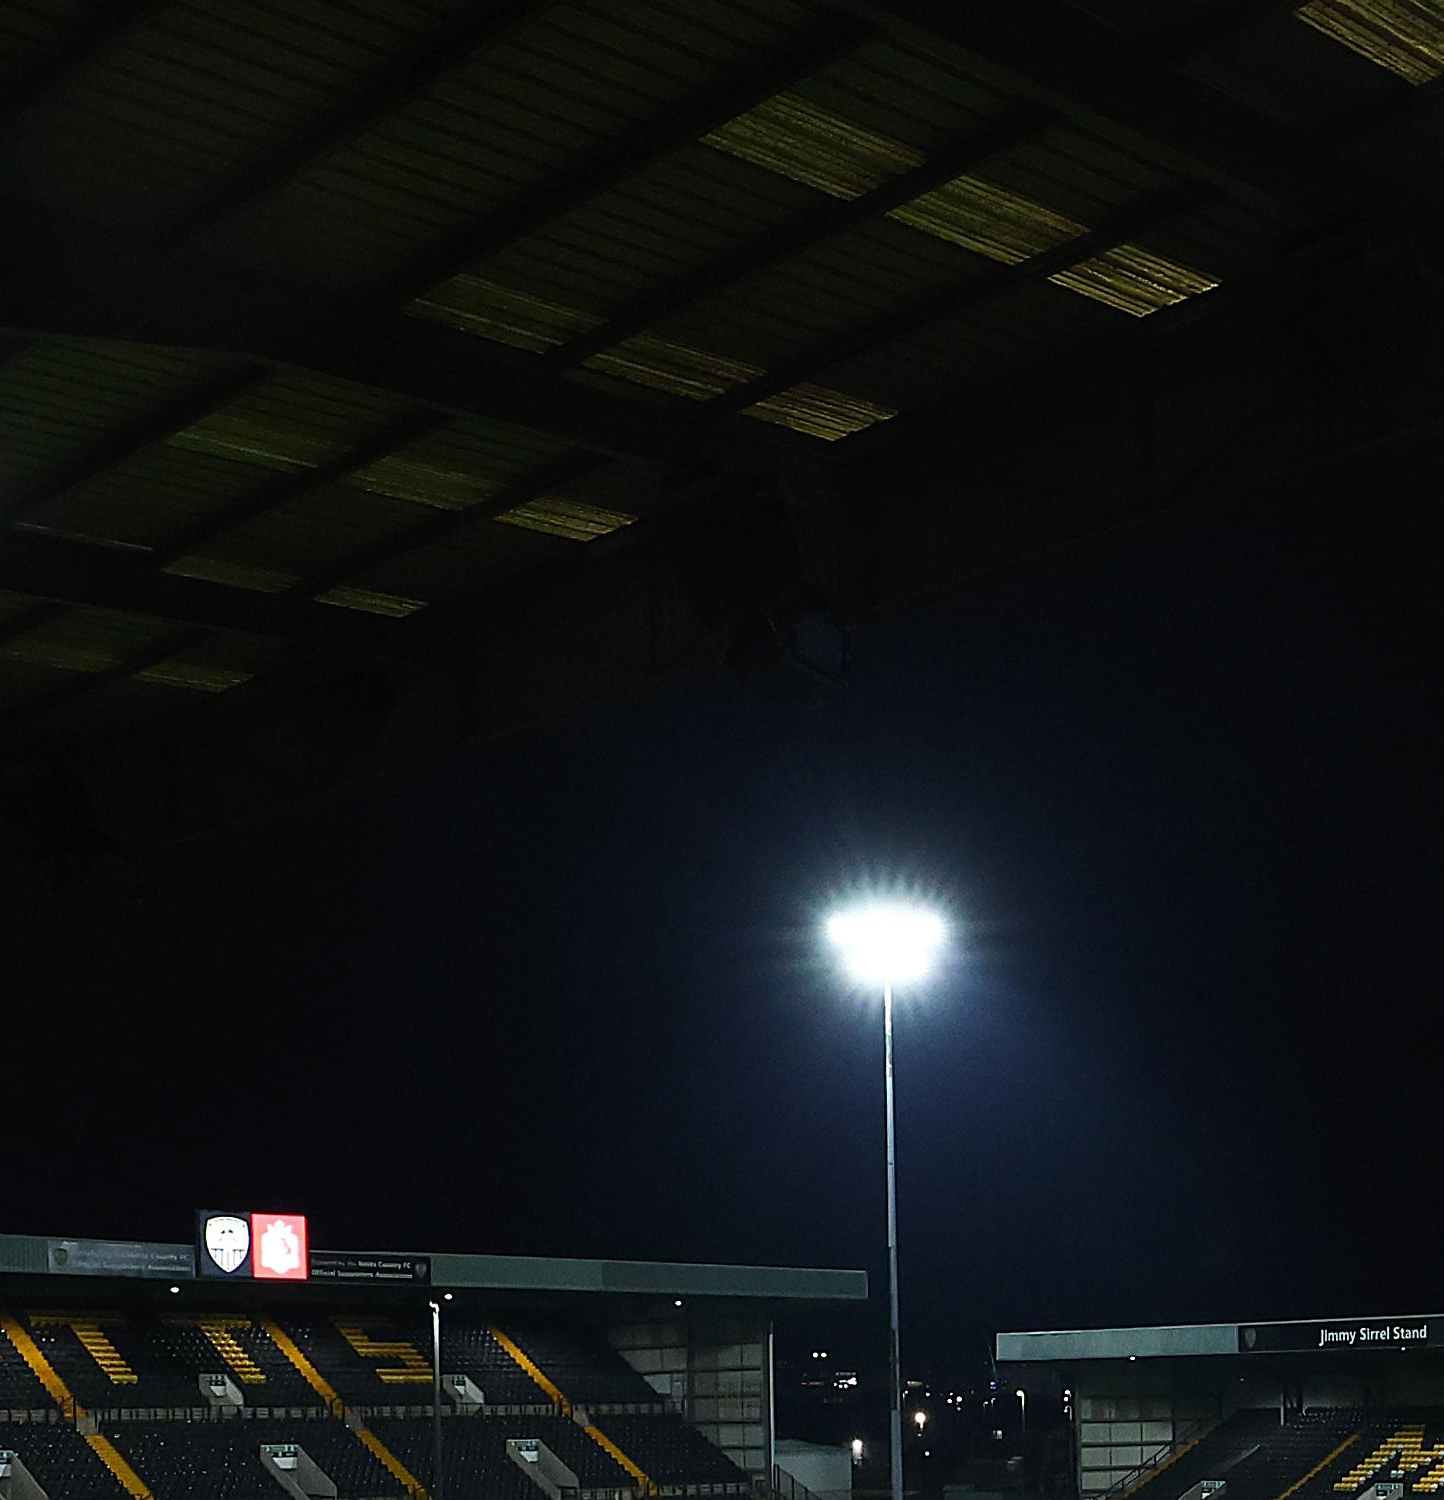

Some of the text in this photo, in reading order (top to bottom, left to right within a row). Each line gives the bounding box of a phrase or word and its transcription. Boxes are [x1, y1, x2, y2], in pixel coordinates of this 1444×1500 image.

[1318, 1324, 1427, 1347] Jimmy Sirrel Stand
